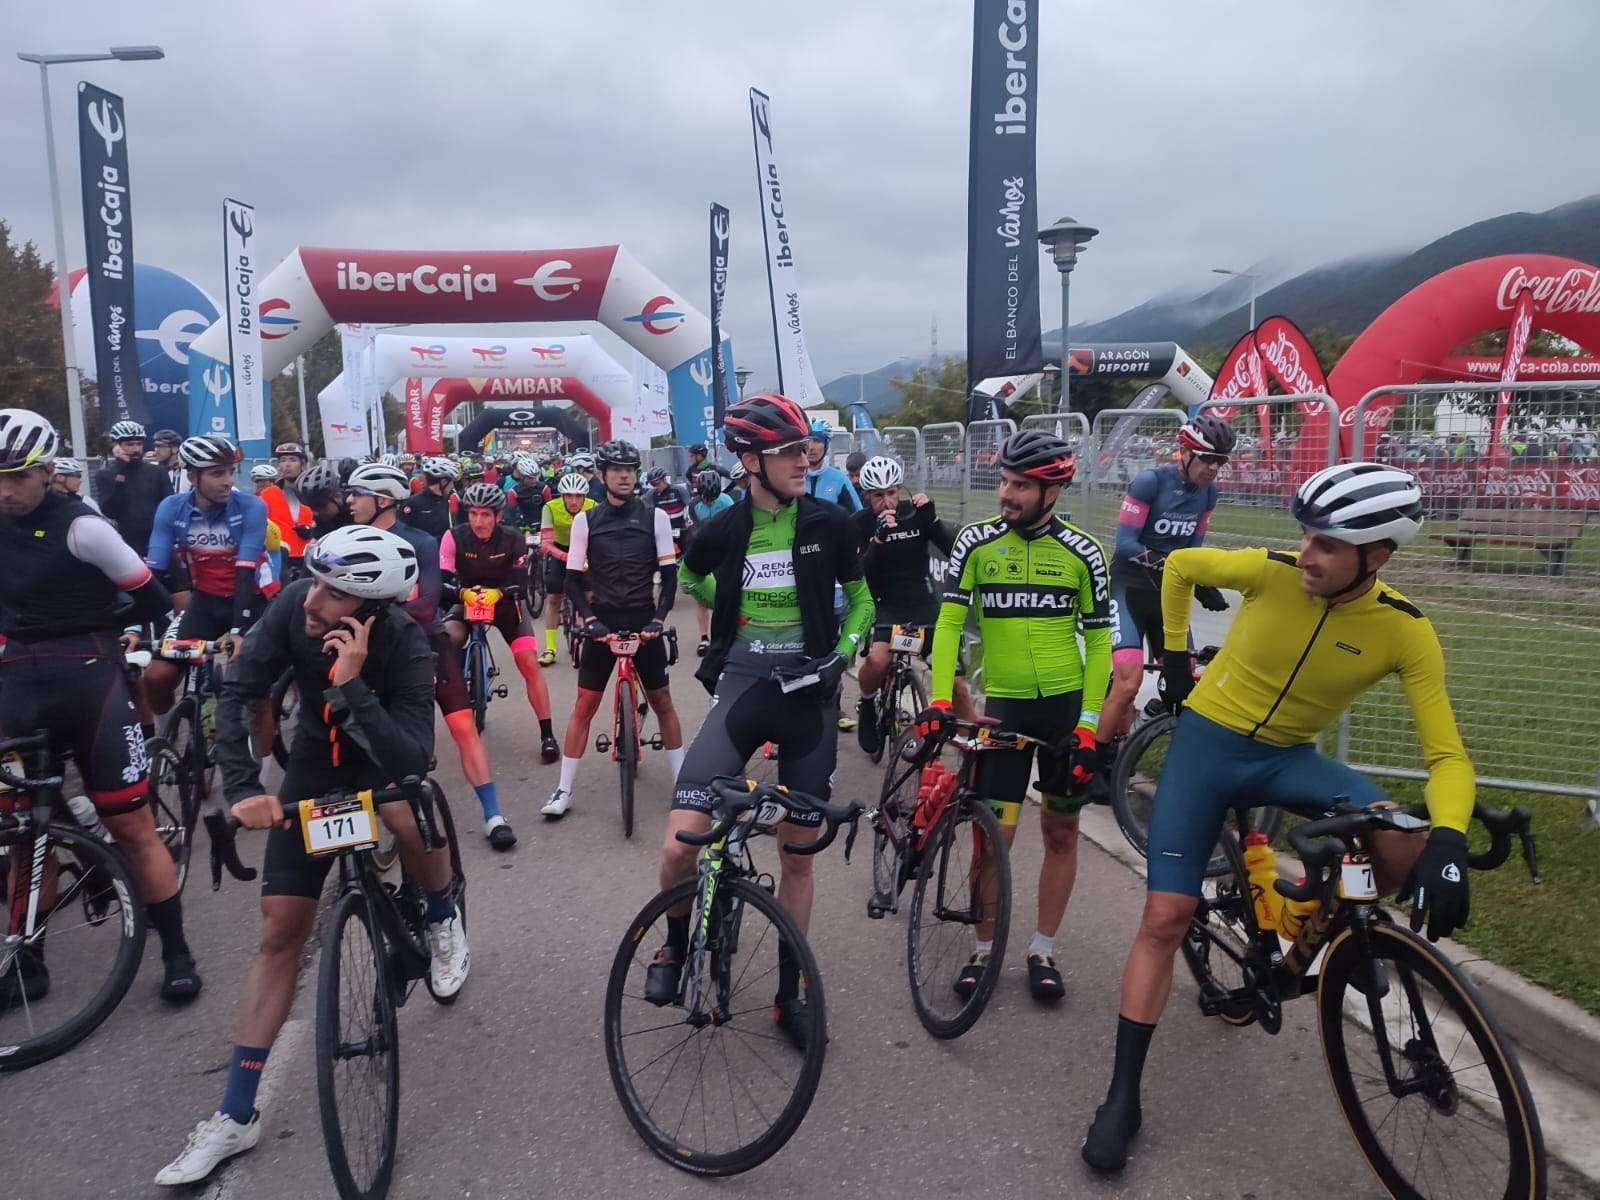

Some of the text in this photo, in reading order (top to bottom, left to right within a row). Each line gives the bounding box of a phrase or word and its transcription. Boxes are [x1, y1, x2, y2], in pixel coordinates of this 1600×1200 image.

[97, 165, 126, 280] iberCaja
[1008, 254, 1018, 282] DEL
[337, 262, 497, 301] iberCaja
[235, 254, 254, 335] iberCaja
[1006, 286, 1018, 338] BANCO
[1006, 342, 1017, 360] EL
[1099, 348, 1150, 360] ARAGÓN
[112, 355, 120, 373] DEL
[1098, 362, 1150, 373] DEPORTE
[1467, 360, 1600, 373] www.ca-cola.com
[113, 375, 126, 408] BANCO
[490, 377, 565, 395] AMBAR
[410, 388, 423, 429] AMBAR
[431, 405, 442, 442] AMBAR
[1154, 518, 1198, 537] OTIS
[757, 569, 785, 579] AUTO
[1057, 528, 1108, 602] MURIAS
[981, 591, 1071, 609] MURIAS
[1109, 599, 1122, 646] OTIS
[618, 642, 630, 651] 47
[901, 638, 913, 648] 48
[322, 816, 355, 840] 171
[30, 832, 48, 891] CANYON
[1361, 868, 1371, 889] 7
